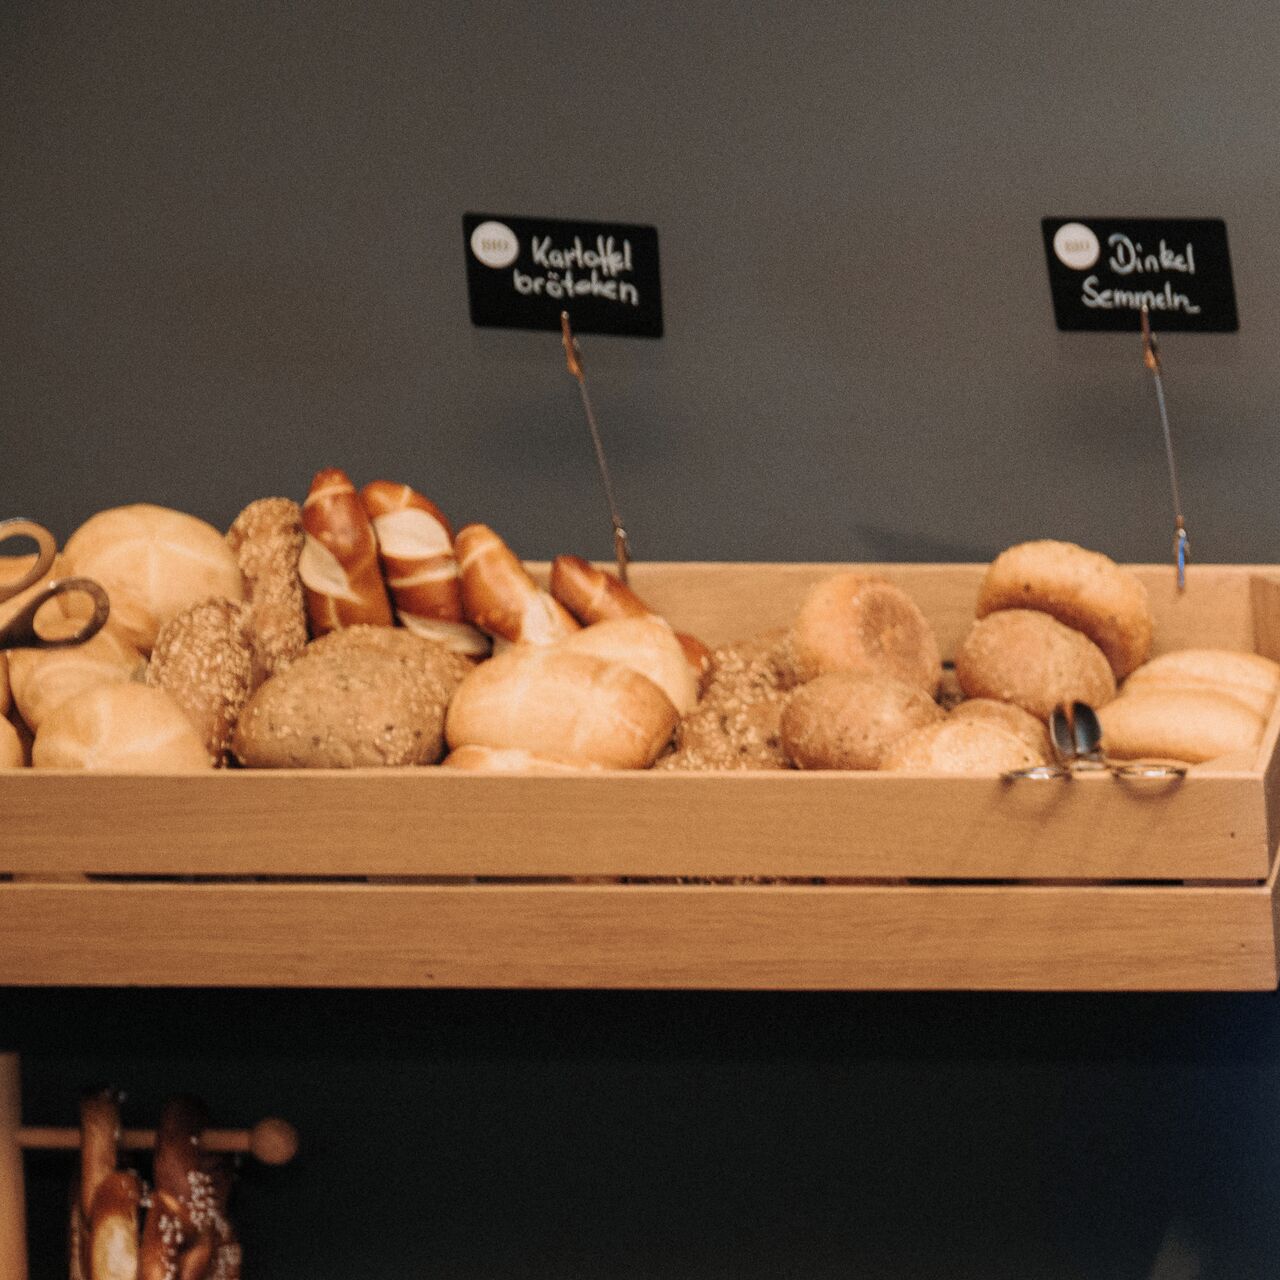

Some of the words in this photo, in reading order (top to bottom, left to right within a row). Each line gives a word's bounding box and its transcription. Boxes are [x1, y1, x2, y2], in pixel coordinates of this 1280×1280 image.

[1107, 232, 1195, 275] Dinkel
[513, 267, 638, 306] brötchen
[1081, 275, 1200, 314] Semmeln
